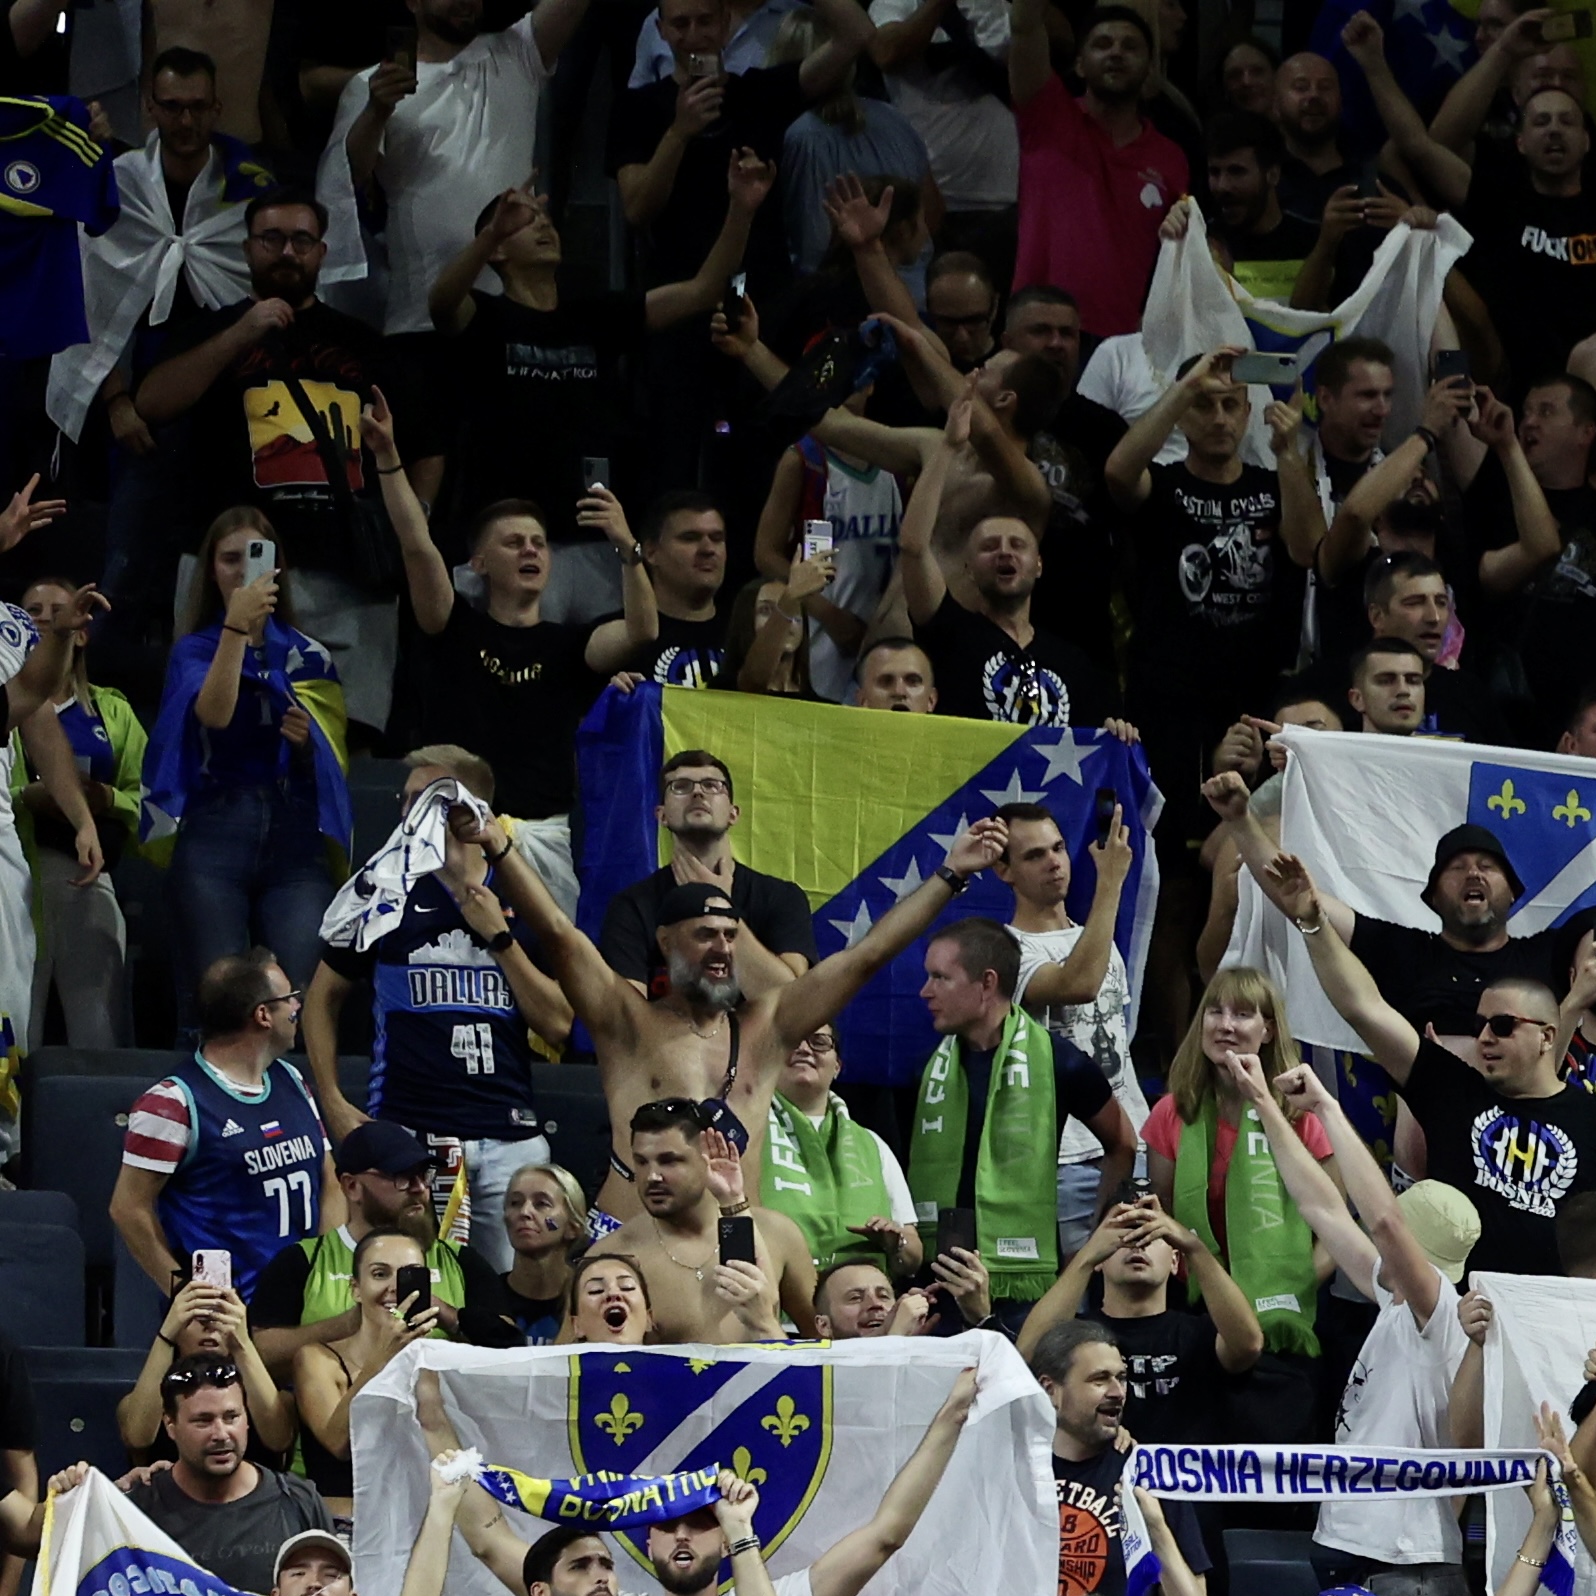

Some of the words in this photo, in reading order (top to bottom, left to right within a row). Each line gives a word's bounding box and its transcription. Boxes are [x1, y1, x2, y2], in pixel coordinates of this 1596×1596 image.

[1520, 224, 1569, 262] FUCK
[450, 1022, 496, 1074] 41
[243, 1134, 318, 1177] SLOVENIA
[263, 1170, 313, 1238] 77
[1135, 1446, 1262, 1493] BOSNIA
